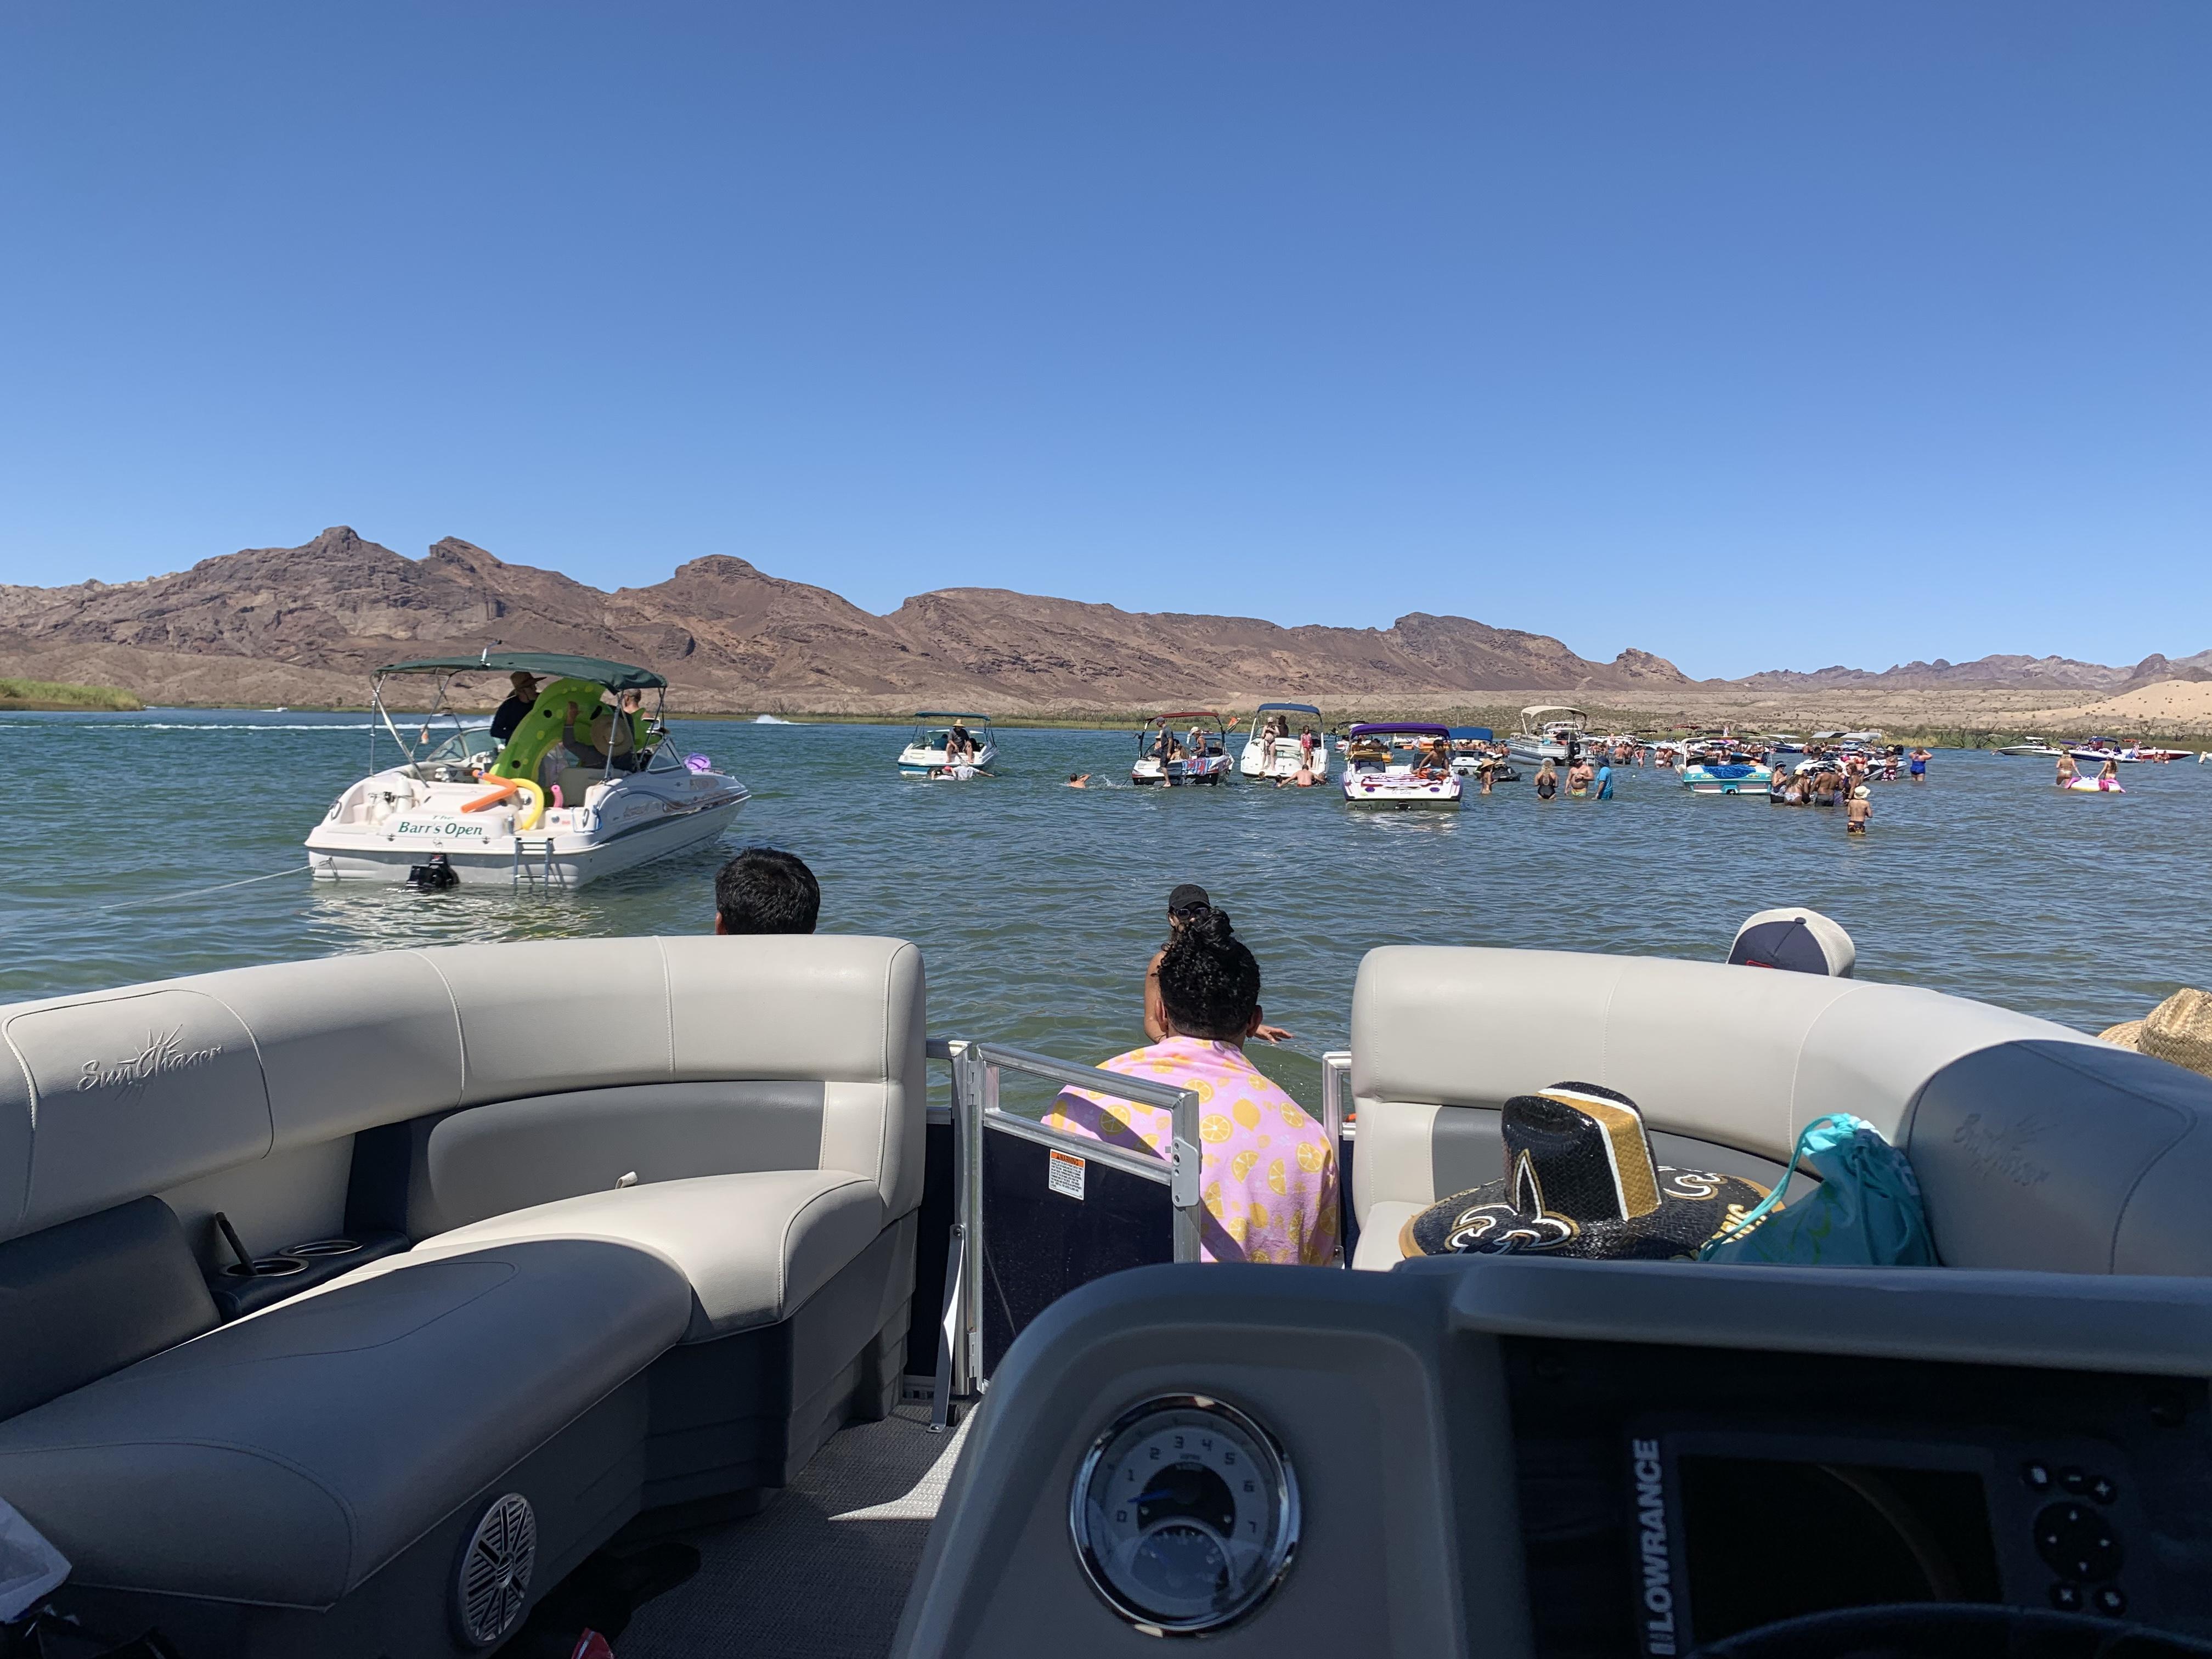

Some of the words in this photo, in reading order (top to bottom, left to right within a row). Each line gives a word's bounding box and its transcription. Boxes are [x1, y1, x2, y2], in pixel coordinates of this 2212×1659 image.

[398, 821, 441, 834] Barr's
[444, 822, 483, 837] Open
[1174, 1436, 1184, 1449] 3
[1201, 1438, 1212, 1452] 4
[1150, 1447, 1160, 1460] 2
[1224, 1452, 1235, 1465] 5
[1127, 1469, 1135, 1482] 1
[1243, 1480, 1255, 1493] 6
[1116, 1510, 1127, 1522] 0
[1248, 1520, 1257, 1533] 7
[1633, 1438, 1674, 1632] LOWRANCE
